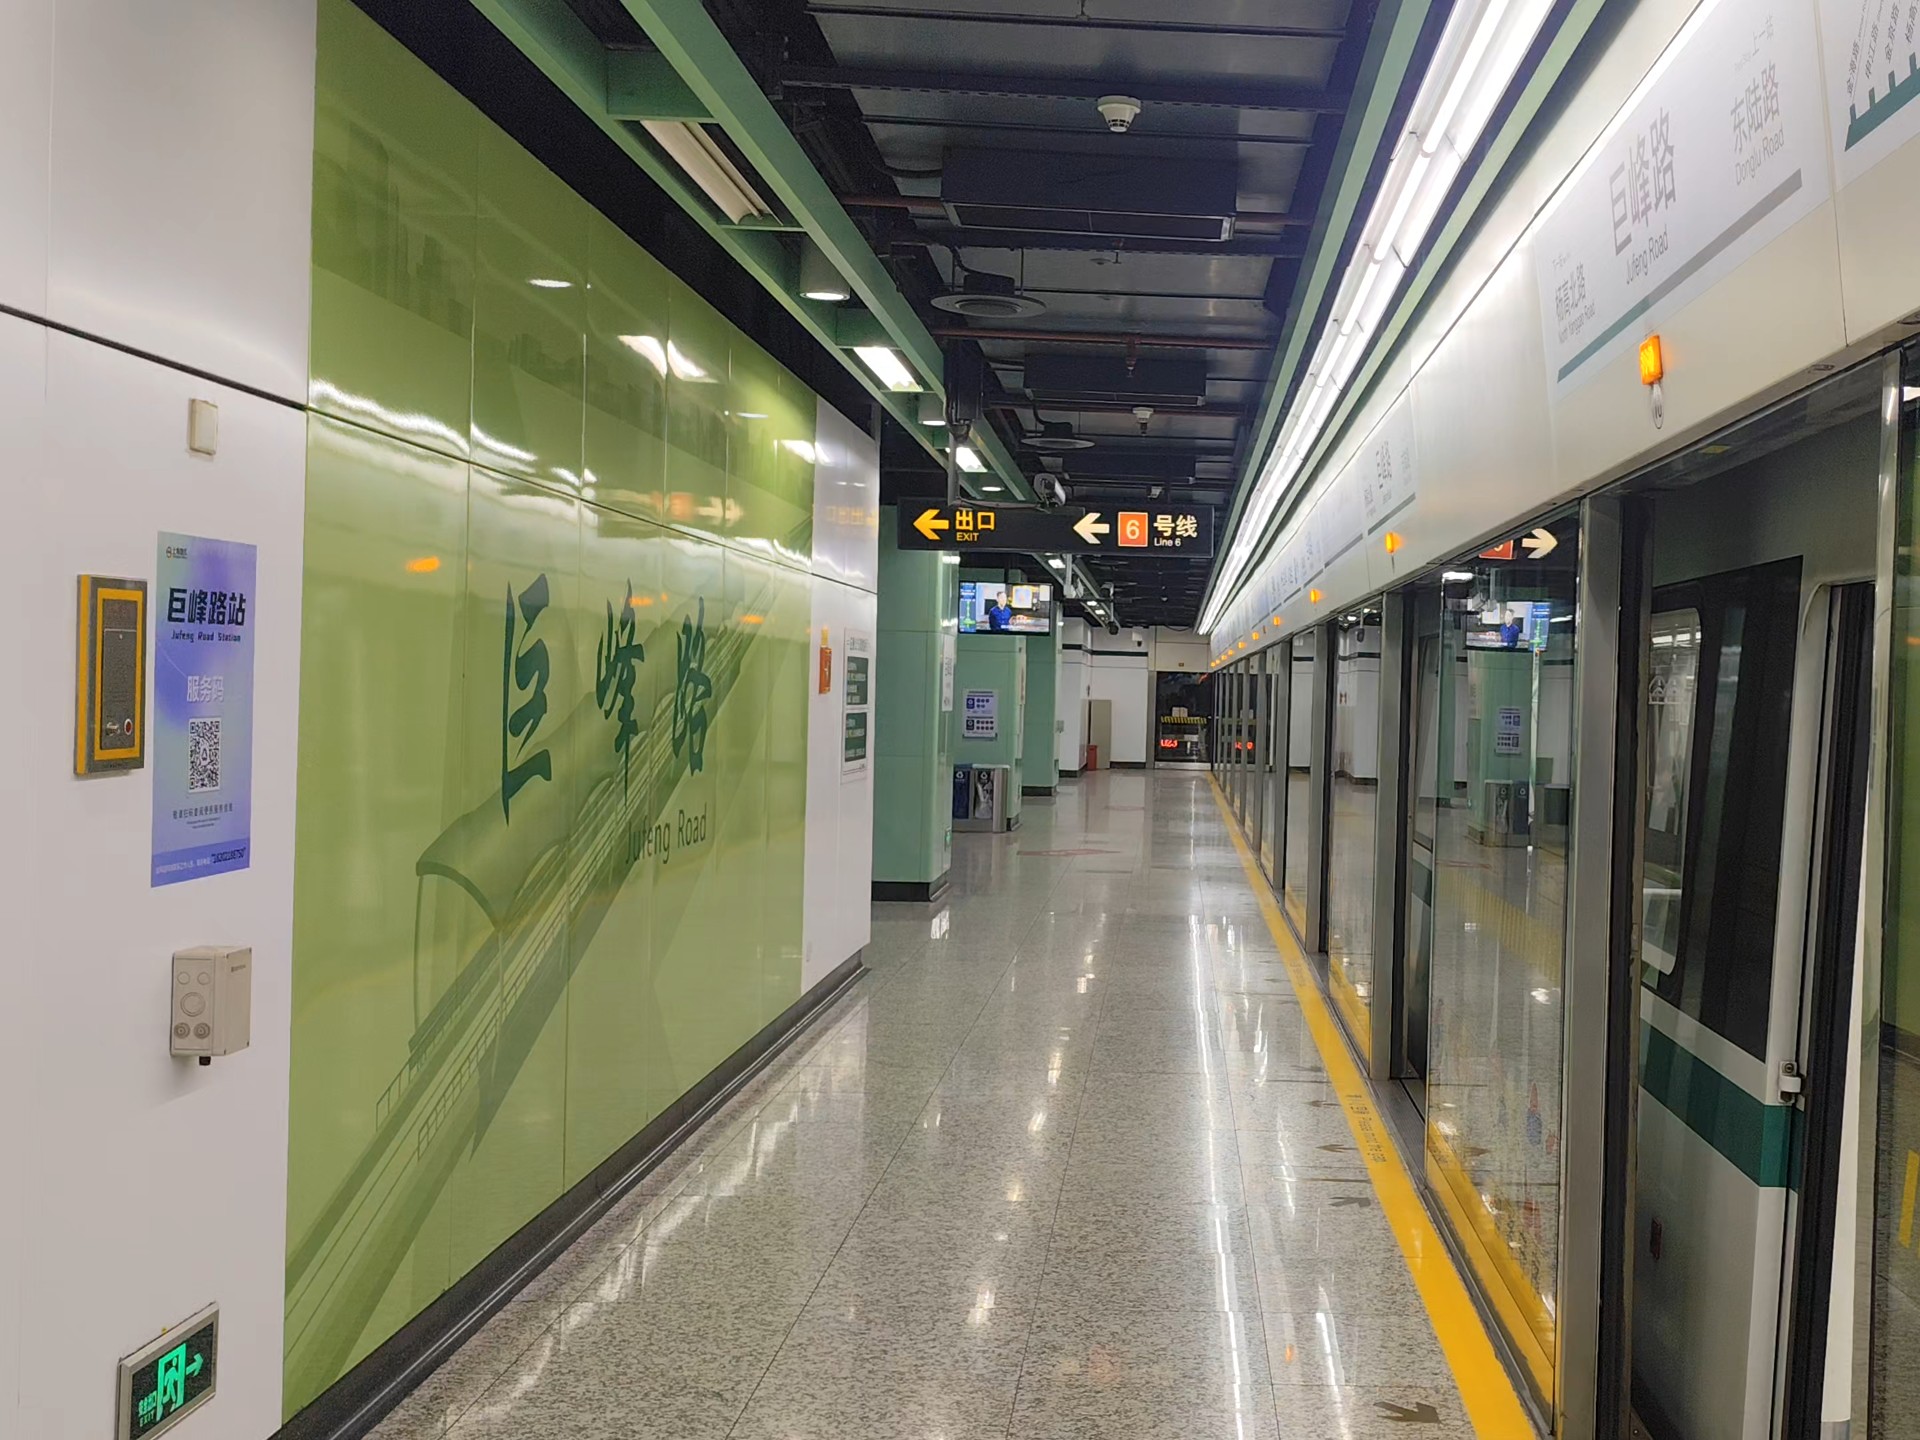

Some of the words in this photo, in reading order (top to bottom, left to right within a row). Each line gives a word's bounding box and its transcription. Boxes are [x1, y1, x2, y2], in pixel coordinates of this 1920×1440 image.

[1731, 60, 1780, 154] 东陆路
[1735, 147, 1762, 186] Donglu
[1762, 124, 1785, 160] Road
[1610, 107, 1676, 256] 巨峰路
[1626, 247, 1648, 285] Jufeng
[1649, 223, 1669, 261] Road
[955, 508, 995, 531] 出口
[956, 532, 979, 541] EXIT
[1126, 519, 1140, 540] 6
[1153, 515, 1198, 538] 号线
[1153, 537, 1173, 546] Line
[1174, 538, 1182, 546] 6
[167, 587, 246, 626] 巨峰路站
[171, 629, 194, 643] Jufeng
[198, 631, 215, 641] Road
[218, 633, 241, 642] Station
[186, 675, 224, 702] 服务码
[502, 573, 712, 828] 巨峰路
[625, 815, 671, 865] Jufeng
[678, 801, 708, 849] Road
